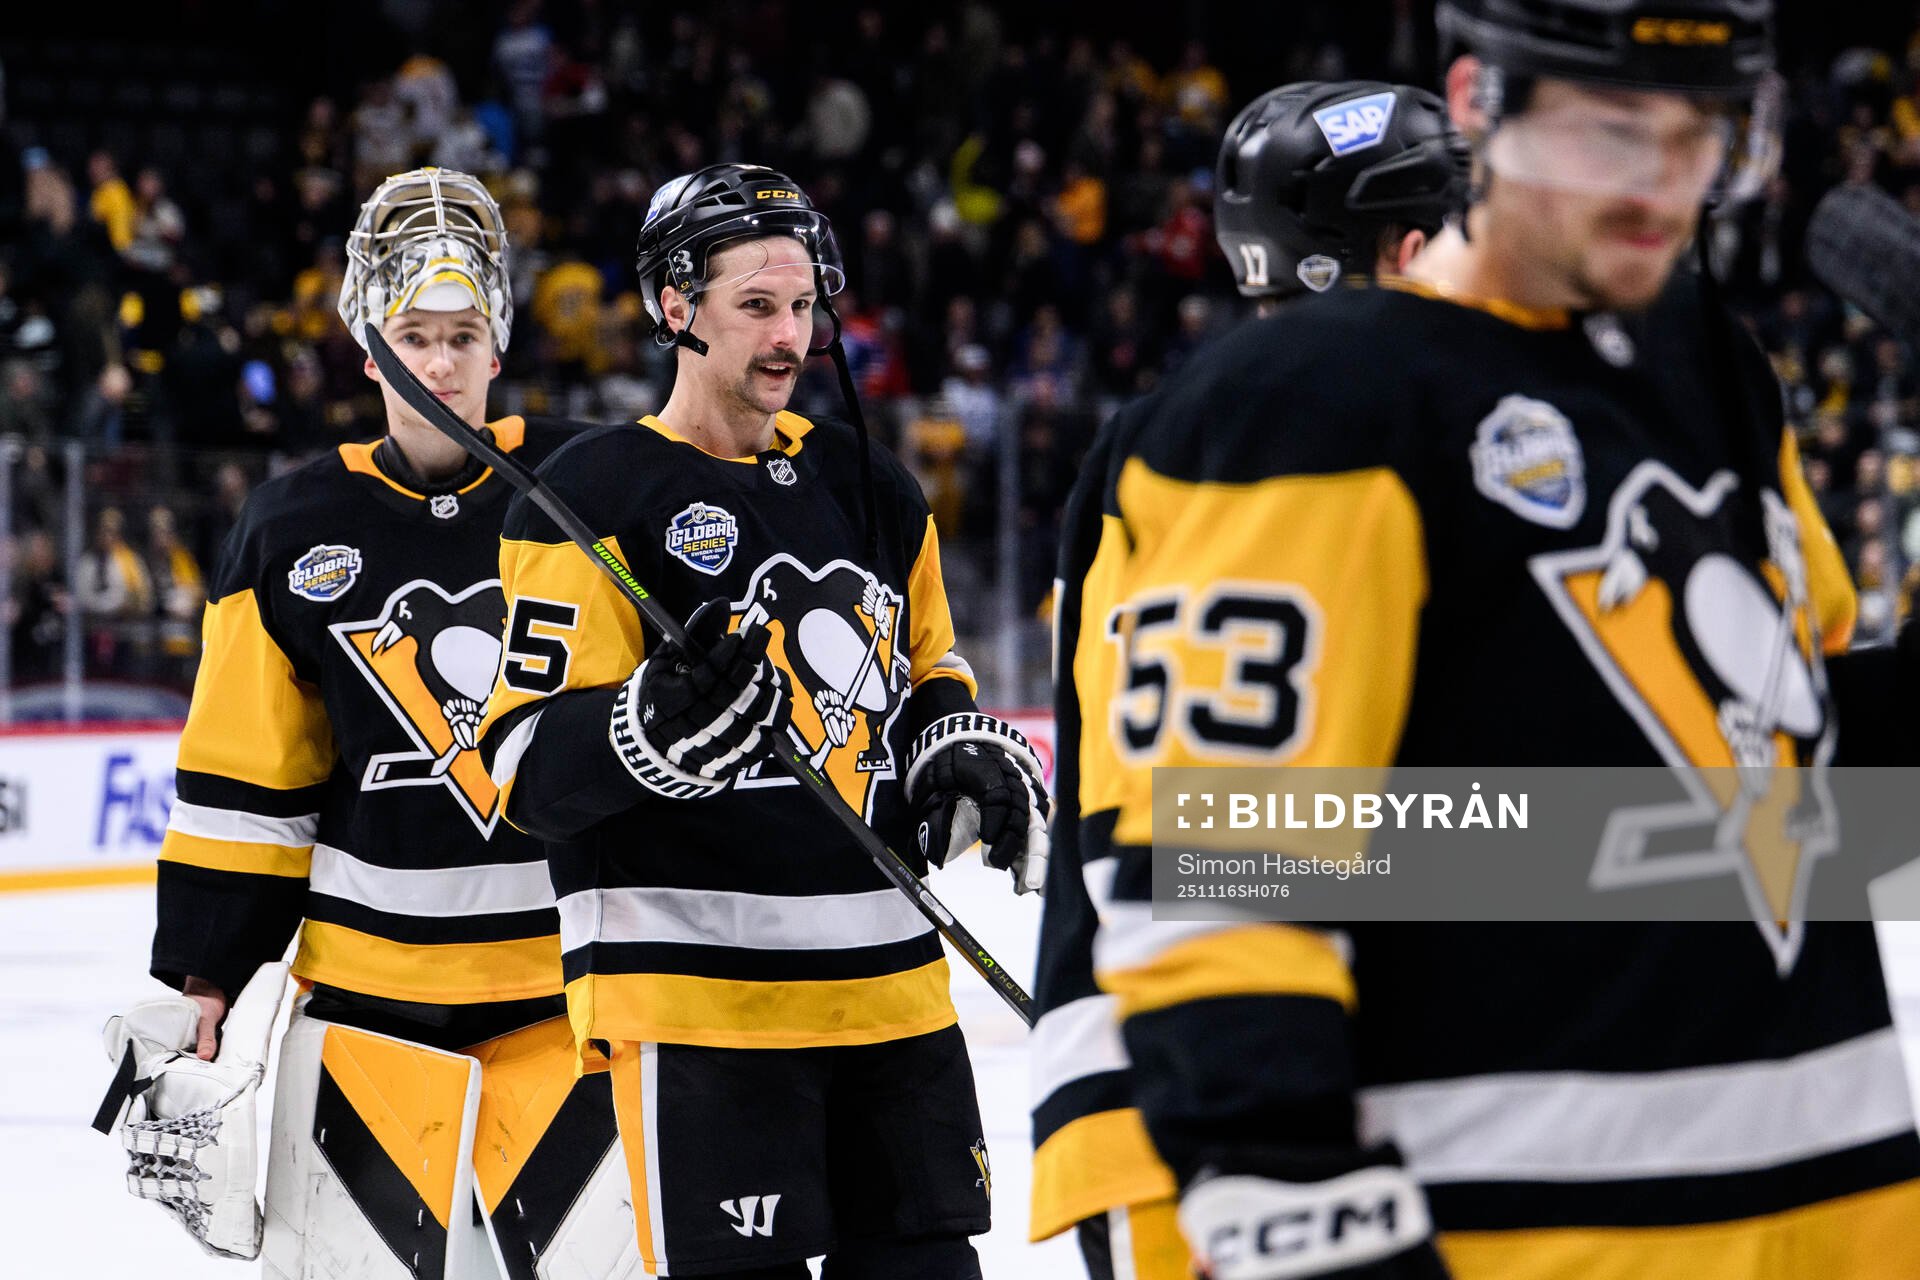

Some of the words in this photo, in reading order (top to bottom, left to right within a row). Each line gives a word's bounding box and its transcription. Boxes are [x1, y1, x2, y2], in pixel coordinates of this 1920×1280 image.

[1323, 105, 1384, 145] SAP
[756, 190, 799, 199] CCM
[1240, 244, 1269, 286] 17
[671, 521, 734, 547] GLOBAL
[683, 537, 726, 553] SERIES
[293, 553, 356, 588] GLOBAL
[303, 568, 346, 589] SERIES
[592, 542, 649, 599] WARRIOR
[502, 594, 580, 697] 5
[1106, 586, 1319, 757] 53
[613, 674, 714, 799] WARRIO
[994, 966, 1029, 1001] ALPHA
[1207, 1198, 1396, 1264] CCM
